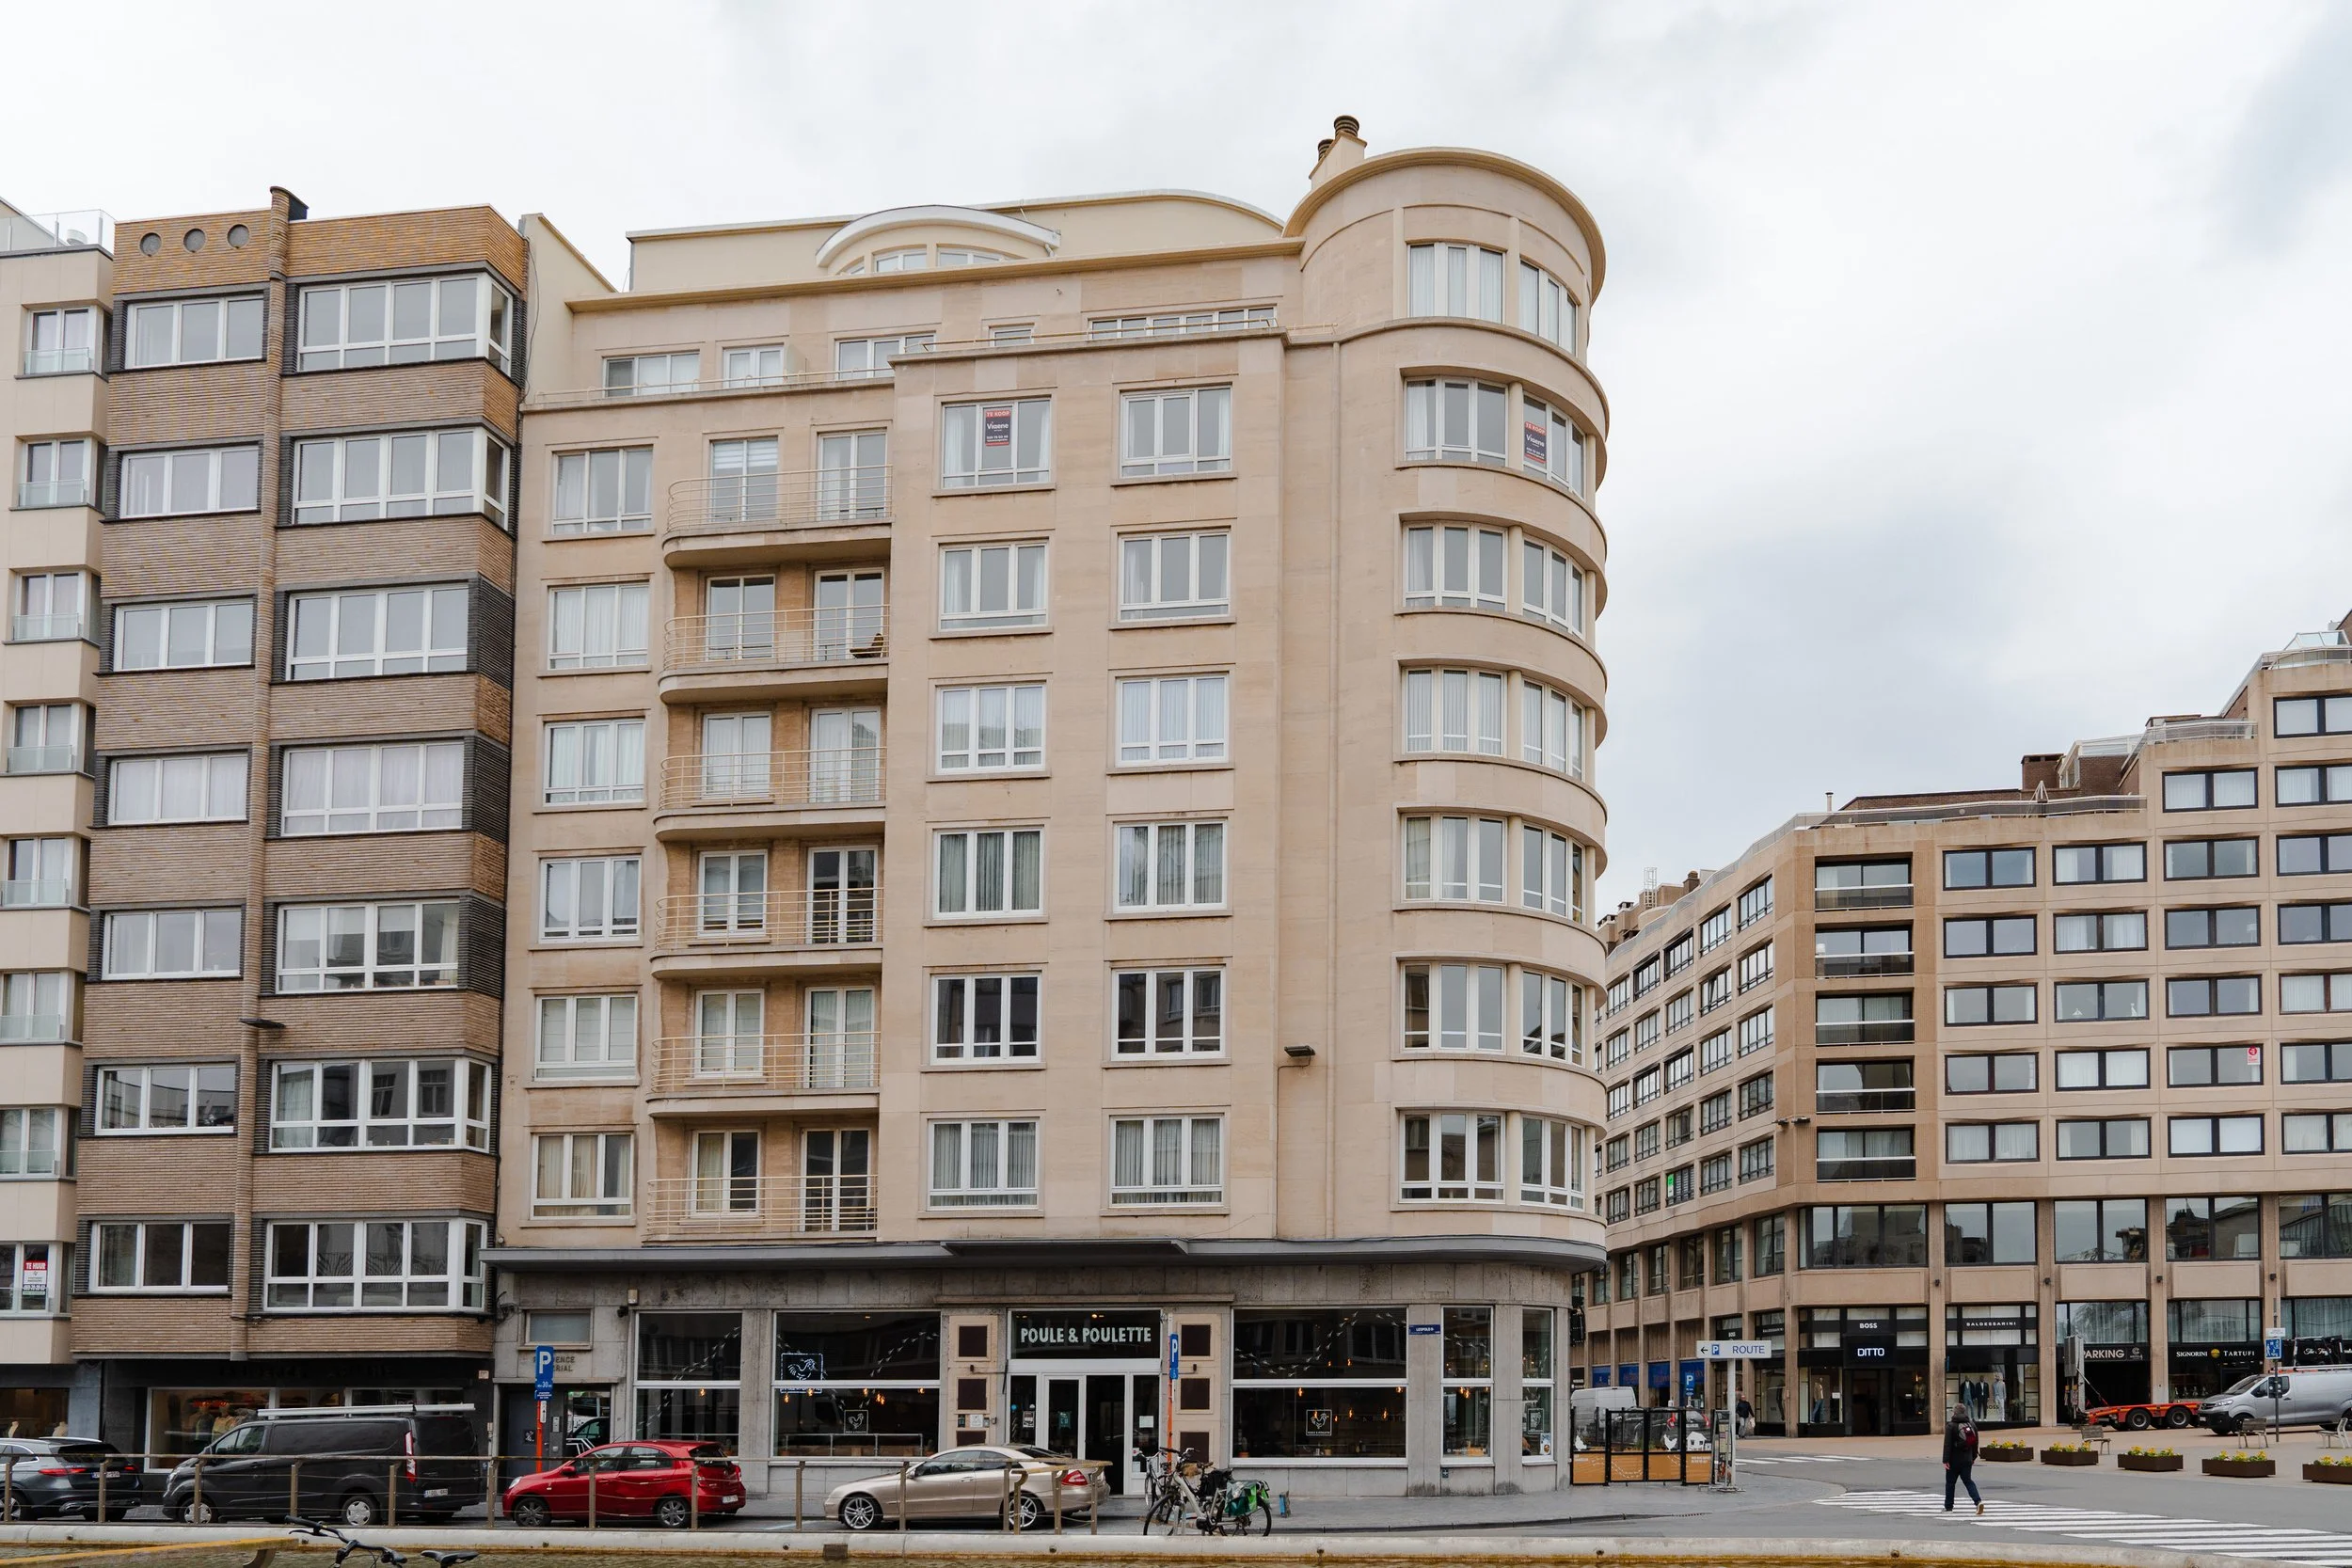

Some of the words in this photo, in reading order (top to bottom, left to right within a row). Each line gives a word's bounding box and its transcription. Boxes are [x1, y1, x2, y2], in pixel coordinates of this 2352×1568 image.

[1021, 1327, 1064, 1343] POULE
[1068, 1327, 1079, 1343] &
[1082, 1326, 1152, 1343] POULETTE
[1171, 1338, 1178, 1363] P
[1732, 1345, 1765, 1354] ROUTE
[1857, 1348, 1884, 1356] DITTO
[539, 1351, 551, 1373] P
[1686, 1374, 1693, 1386] P
